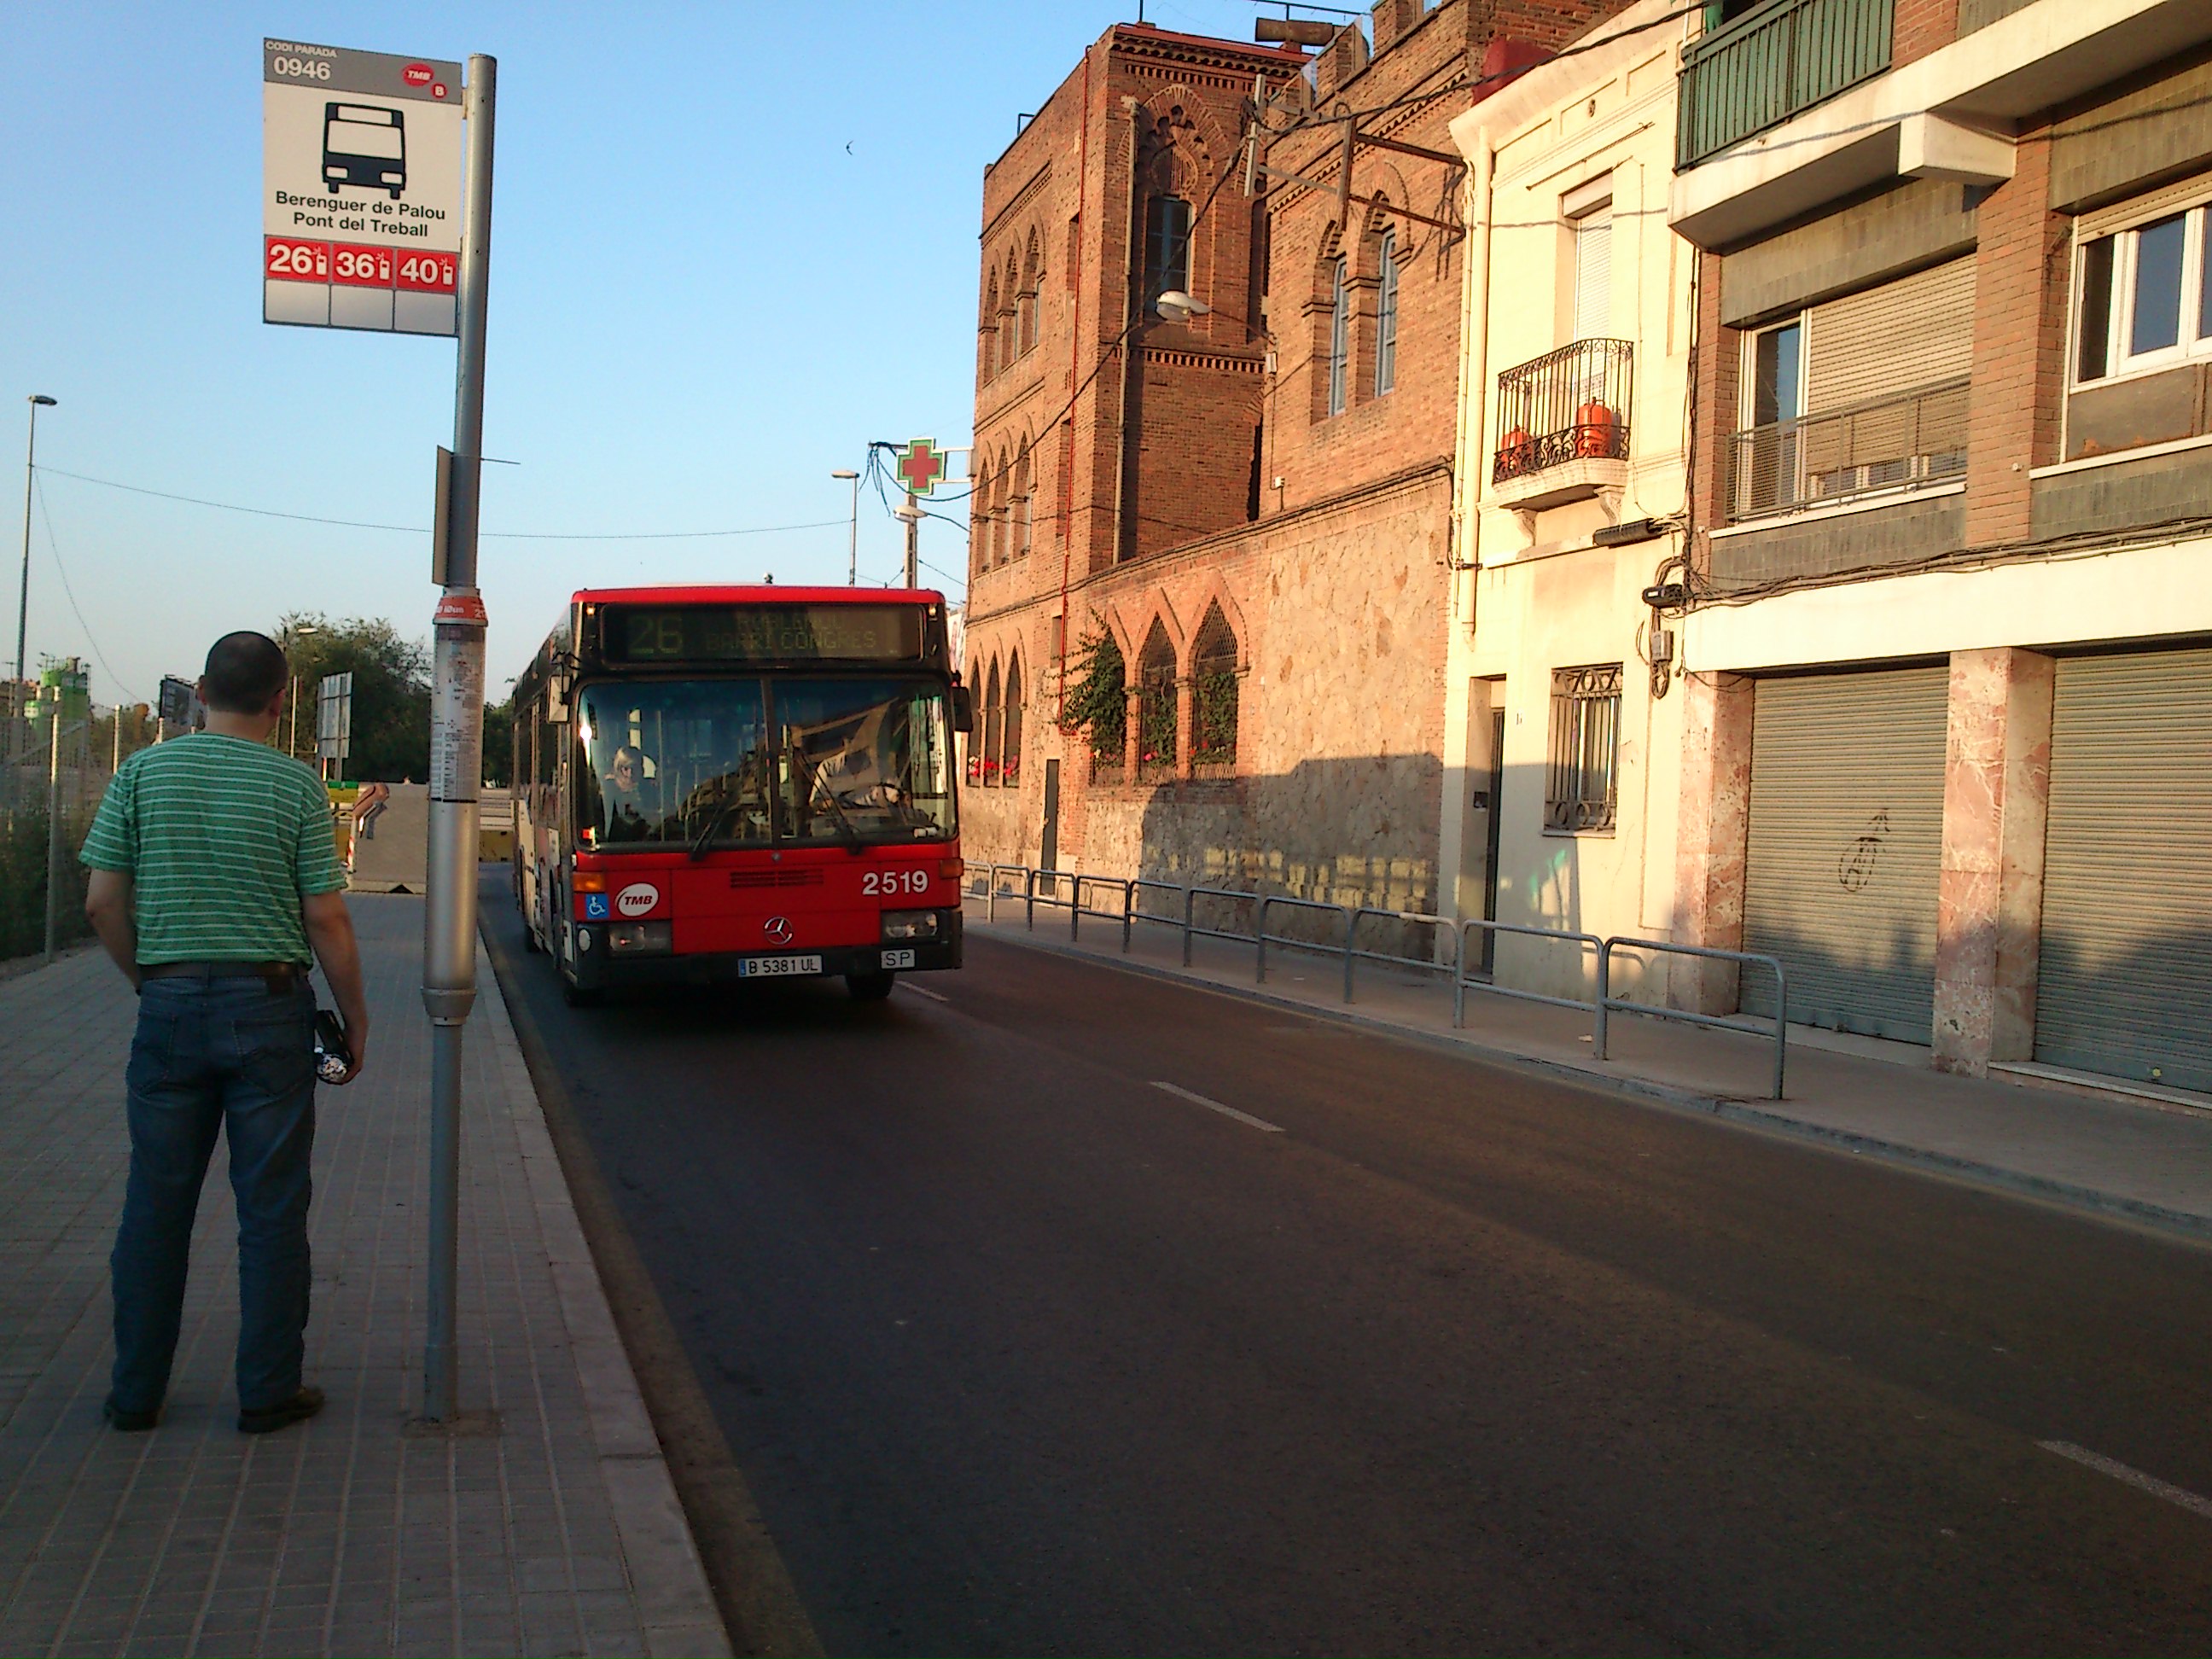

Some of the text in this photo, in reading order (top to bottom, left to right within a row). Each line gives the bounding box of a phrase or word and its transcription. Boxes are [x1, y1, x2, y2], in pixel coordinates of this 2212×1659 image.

[265, 41, 337, 58] CODI PARADA
[273, 55, 331, 80] 0946
[407, 69, 431, 80] TMB
[435, 85, 444, 96] B
[276, 191, 445, 220] Berenguer de Palou
[294, 212, 428, 236] Pont del Treball
[269, 244, 313, 274] 26
[335, 252, 375, 279] 36
[400, 258, 439, 284] 40
[627, 614, 684, 655] 26
[862, 870, 928, 895] 2519
[625, 895, 653, 905] TMB
[748, 958, 818, 974] B 5381 UL
